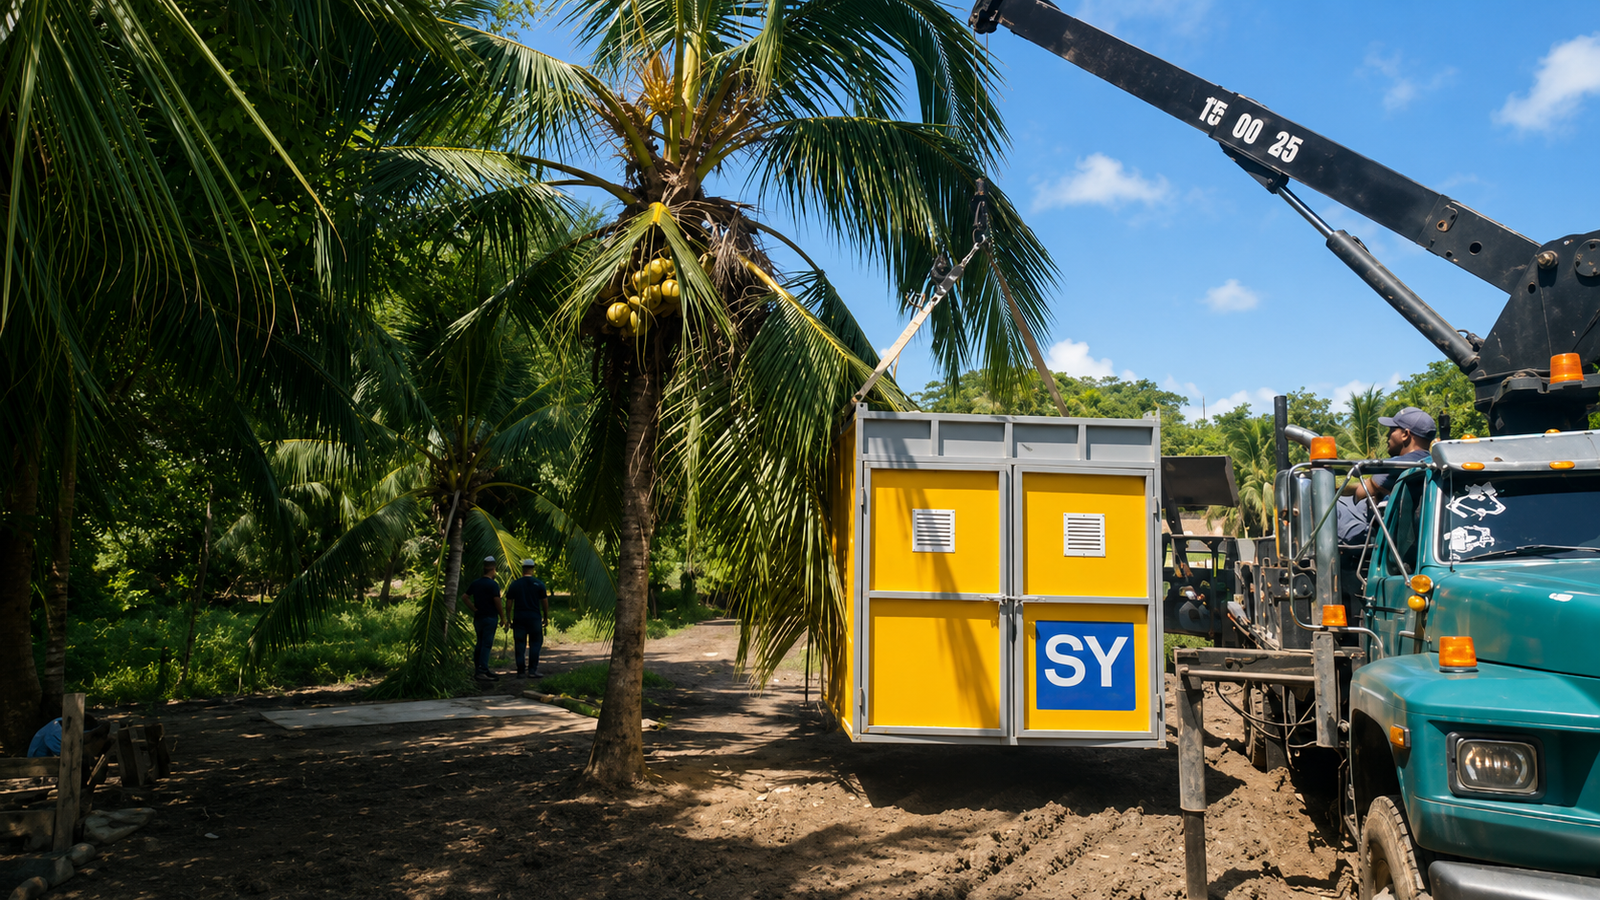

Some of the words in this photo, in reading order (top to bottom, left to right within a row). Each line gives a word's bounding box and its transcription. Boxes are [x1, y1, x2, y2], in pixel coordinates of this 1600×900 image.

[1232, 113, 1264, 145] 00
[1267, 131, 1304, 163] 25
[1044, 634, 1129, 687] SY
